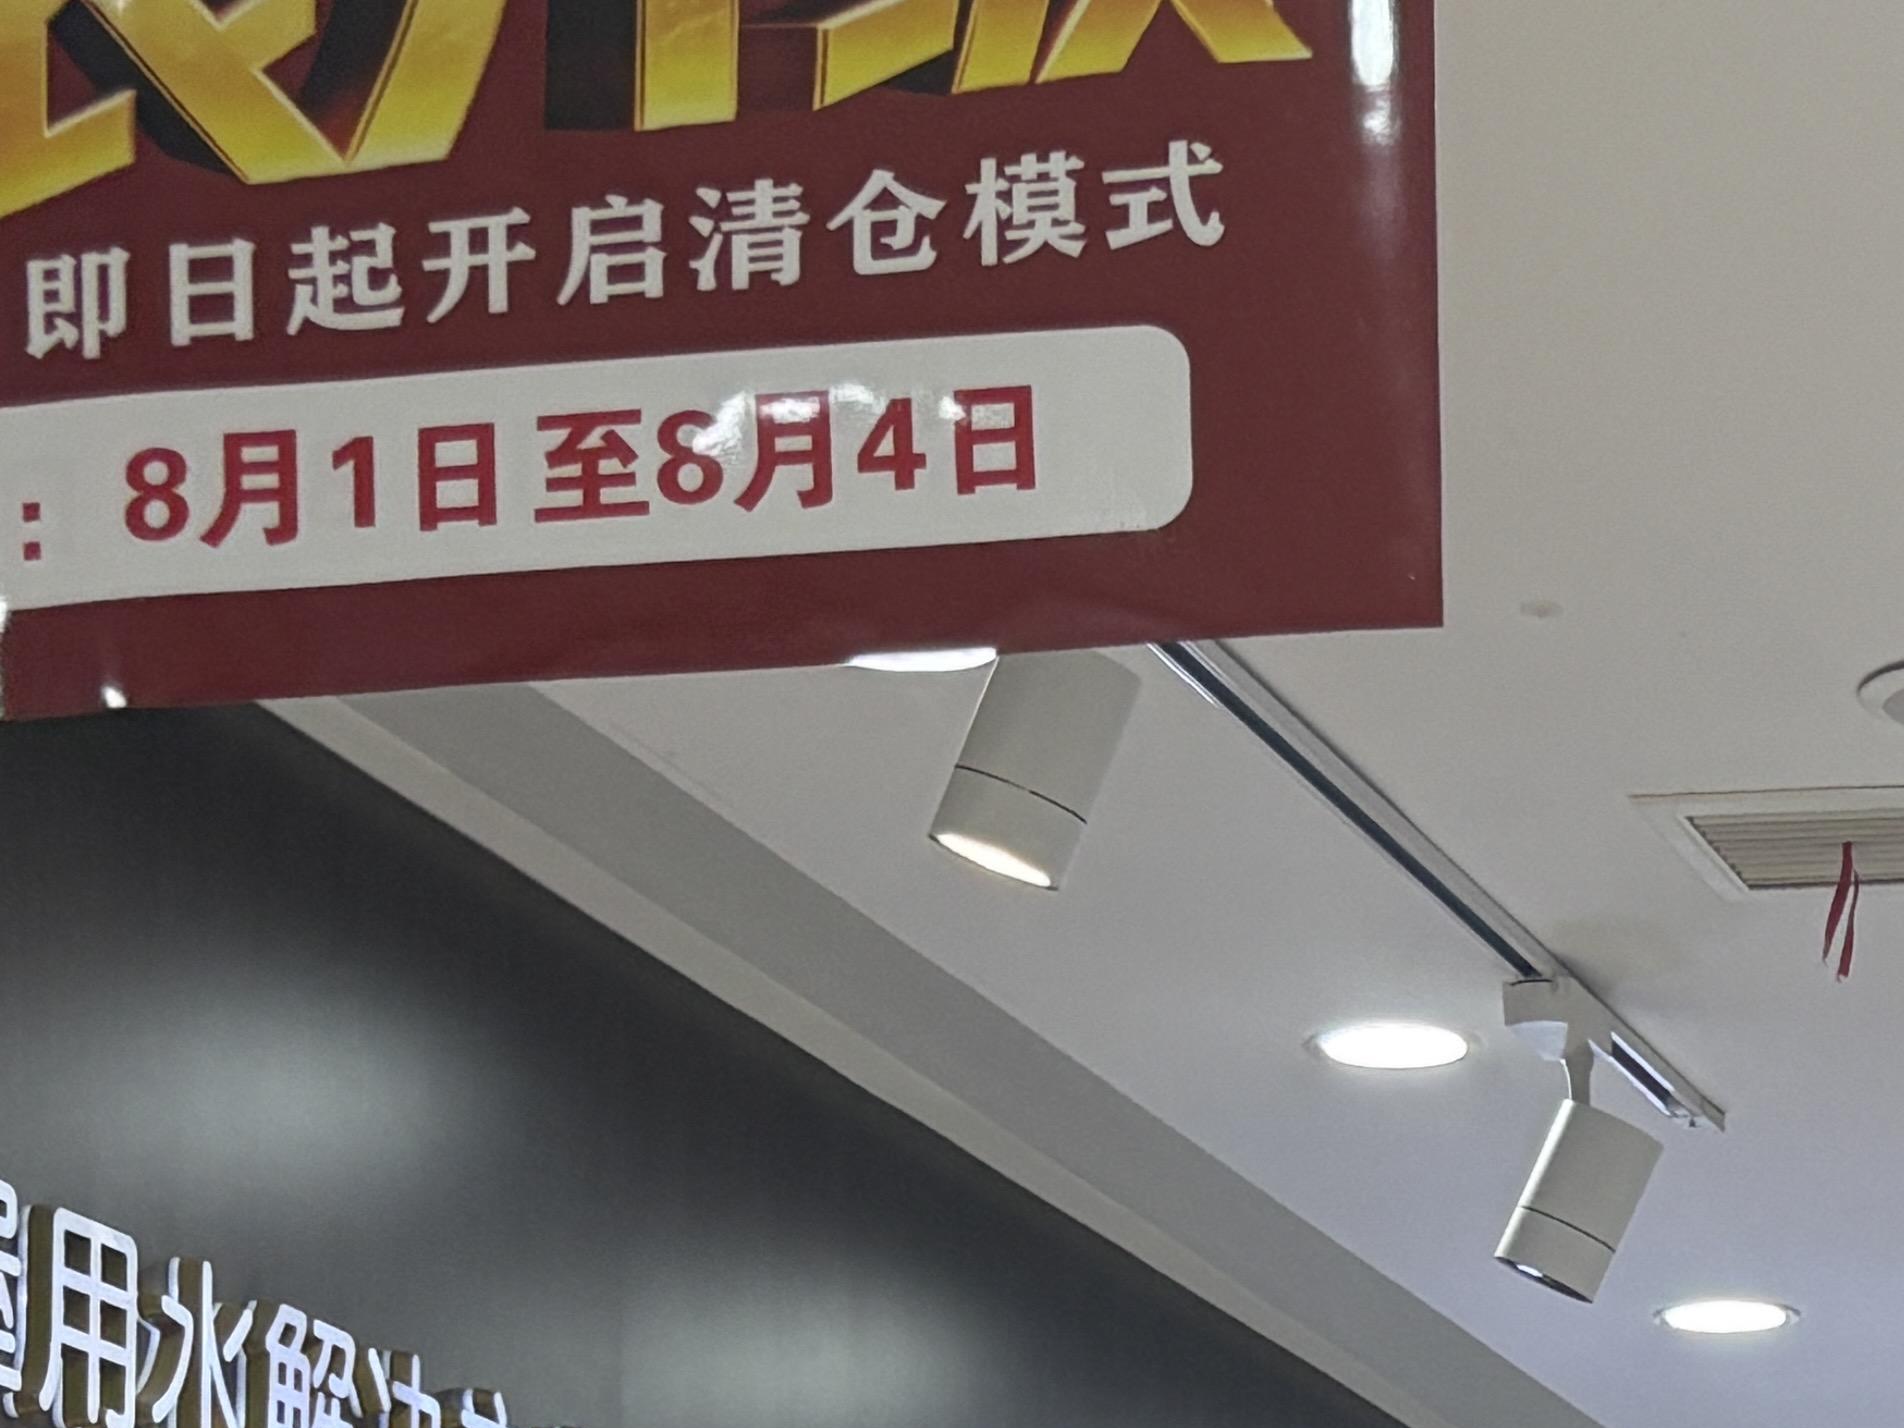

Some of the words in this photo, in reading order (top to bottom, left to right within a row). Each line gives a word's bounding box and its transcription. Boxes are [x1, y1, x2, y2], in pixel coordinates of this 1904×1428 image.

[24, 141, 1227, 361] 即日起开启清仓模式
